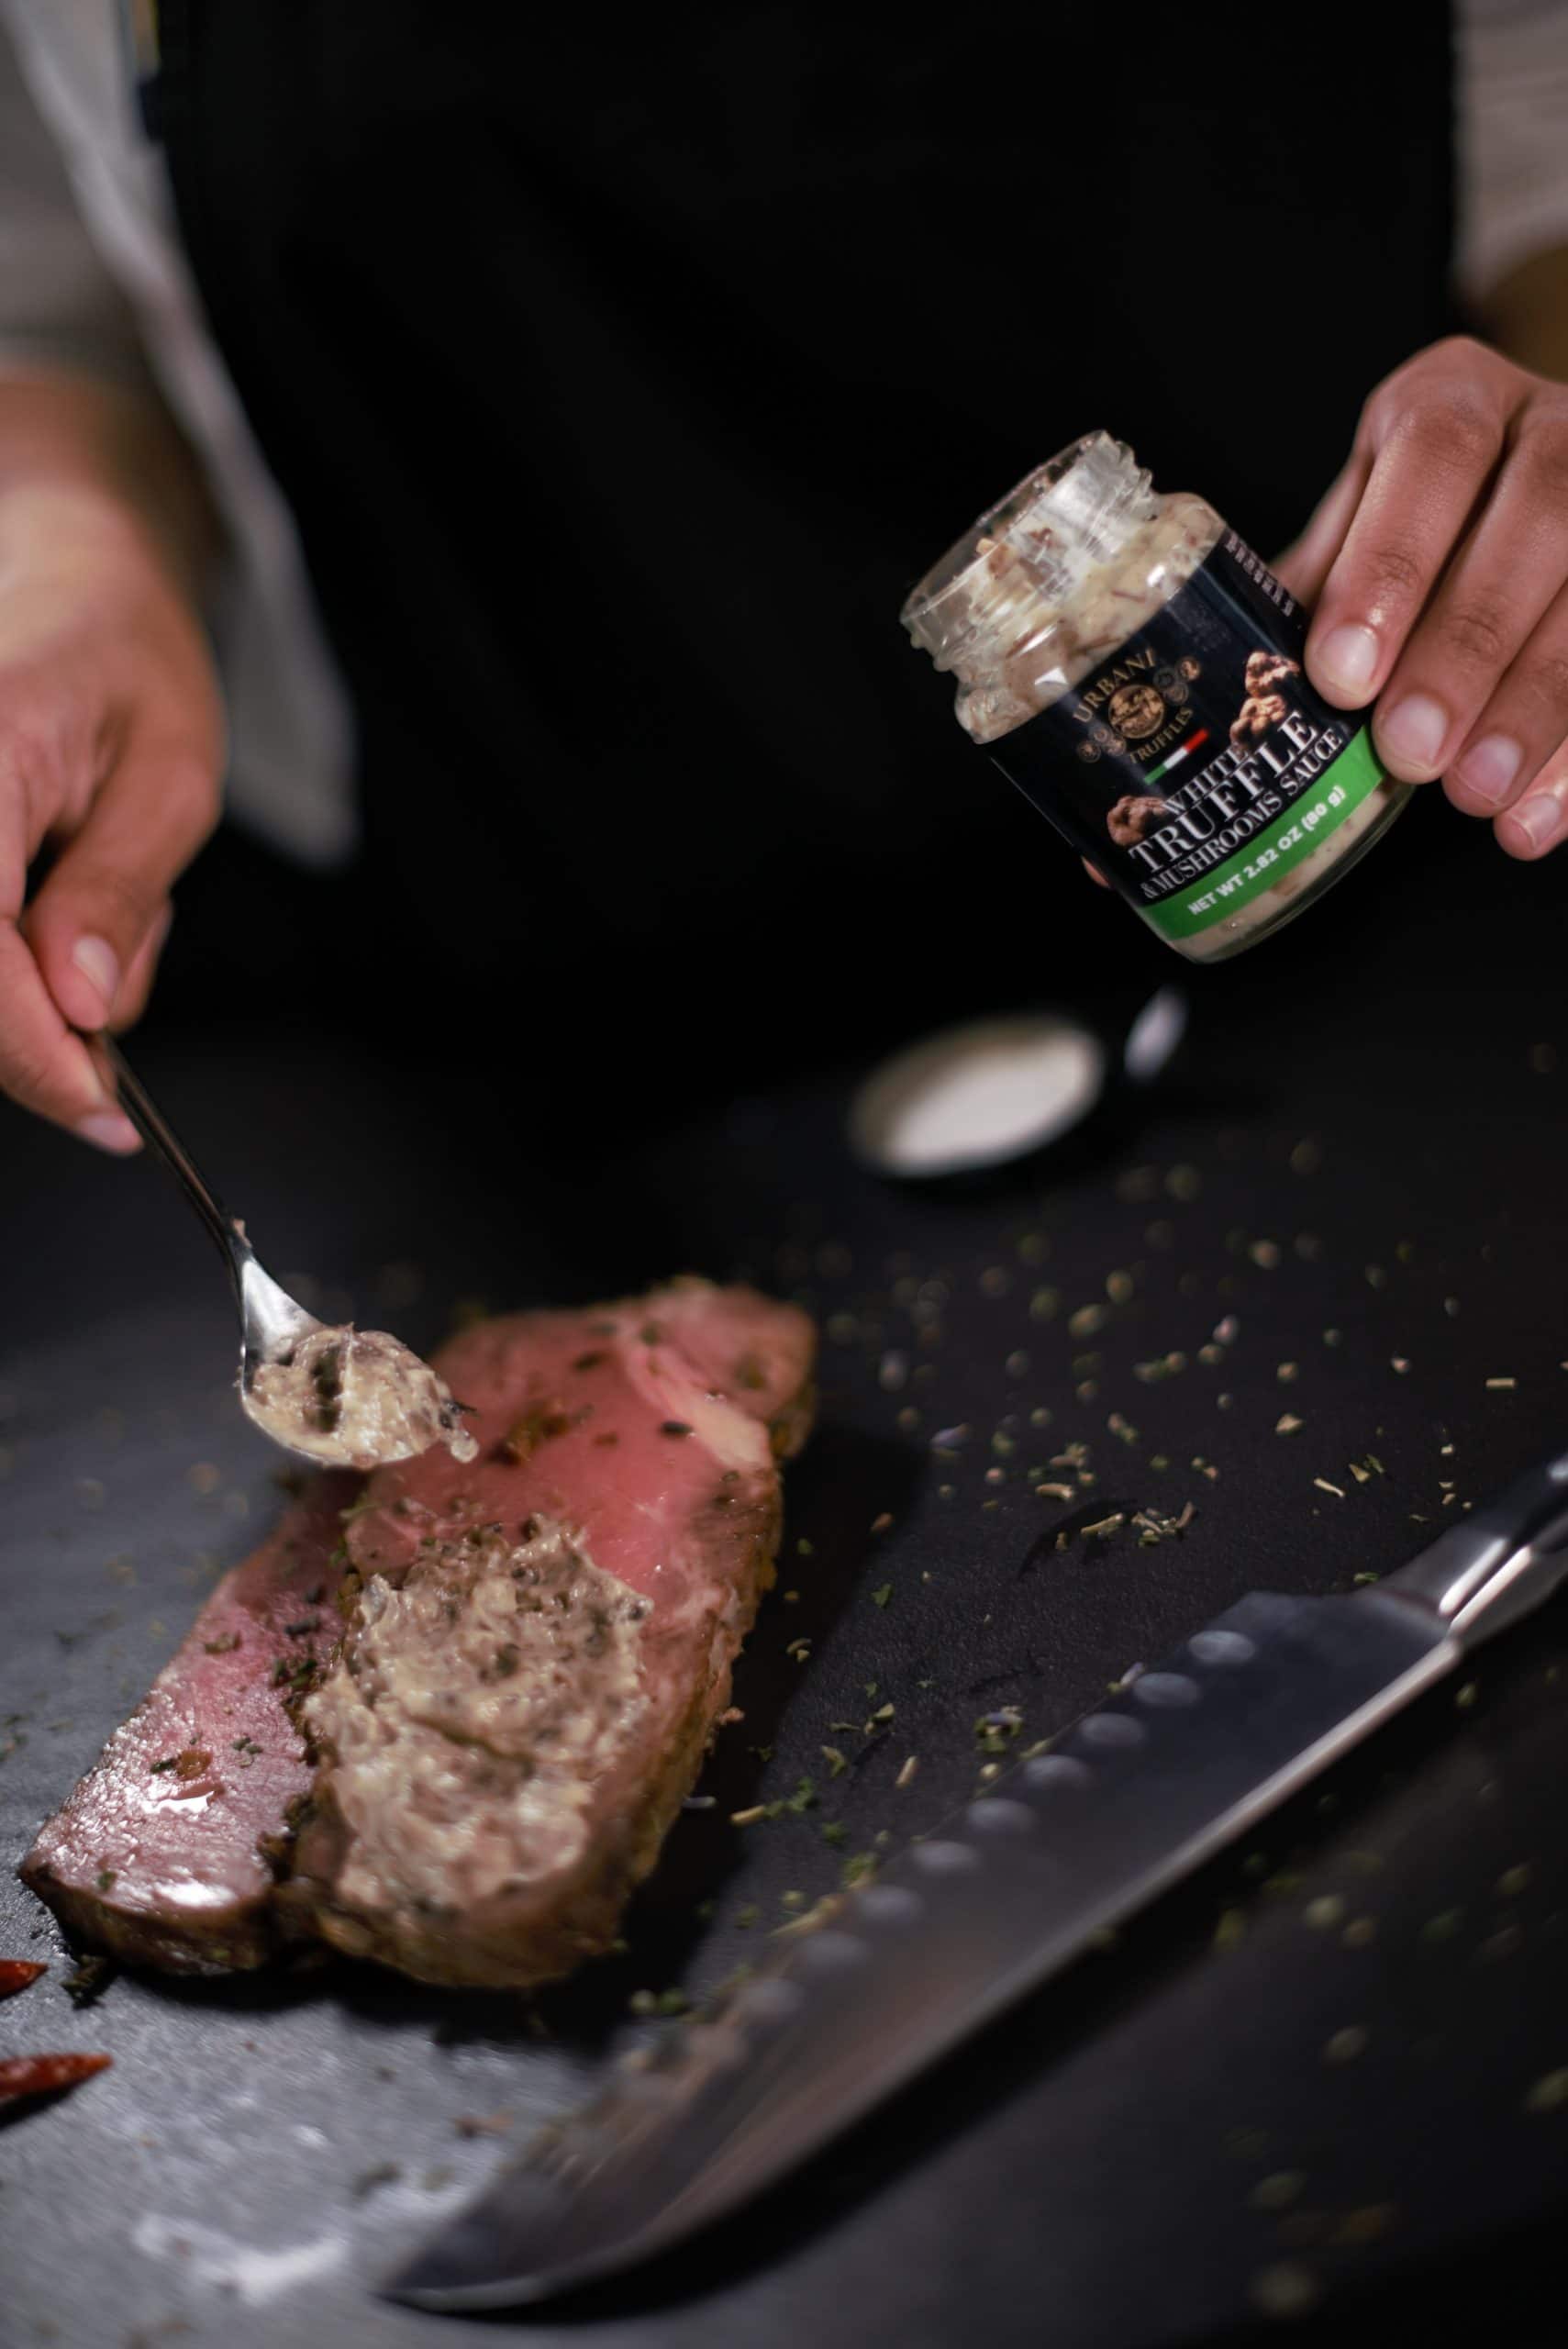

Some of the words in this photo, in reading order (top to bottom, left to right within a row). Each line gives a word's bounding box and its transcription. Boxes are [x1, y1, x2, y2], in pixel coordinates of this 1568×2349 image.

[1072, 648, 1156, 723] URBANI
[1129, 707, 1193, 764] TRUFFLES
[1279, 729, 1344, 796] SAUCE
[1128, 711, 1318, 873] TRUFFLE
[1162, 744, 1249, 816] WHITE
[1187, 891, 1220, 915] NET
[1215, 873, 1246, 897] WT
[1243, 848, 1279, 879] 2.82
[1277, 826, 1303, 852] OZ
